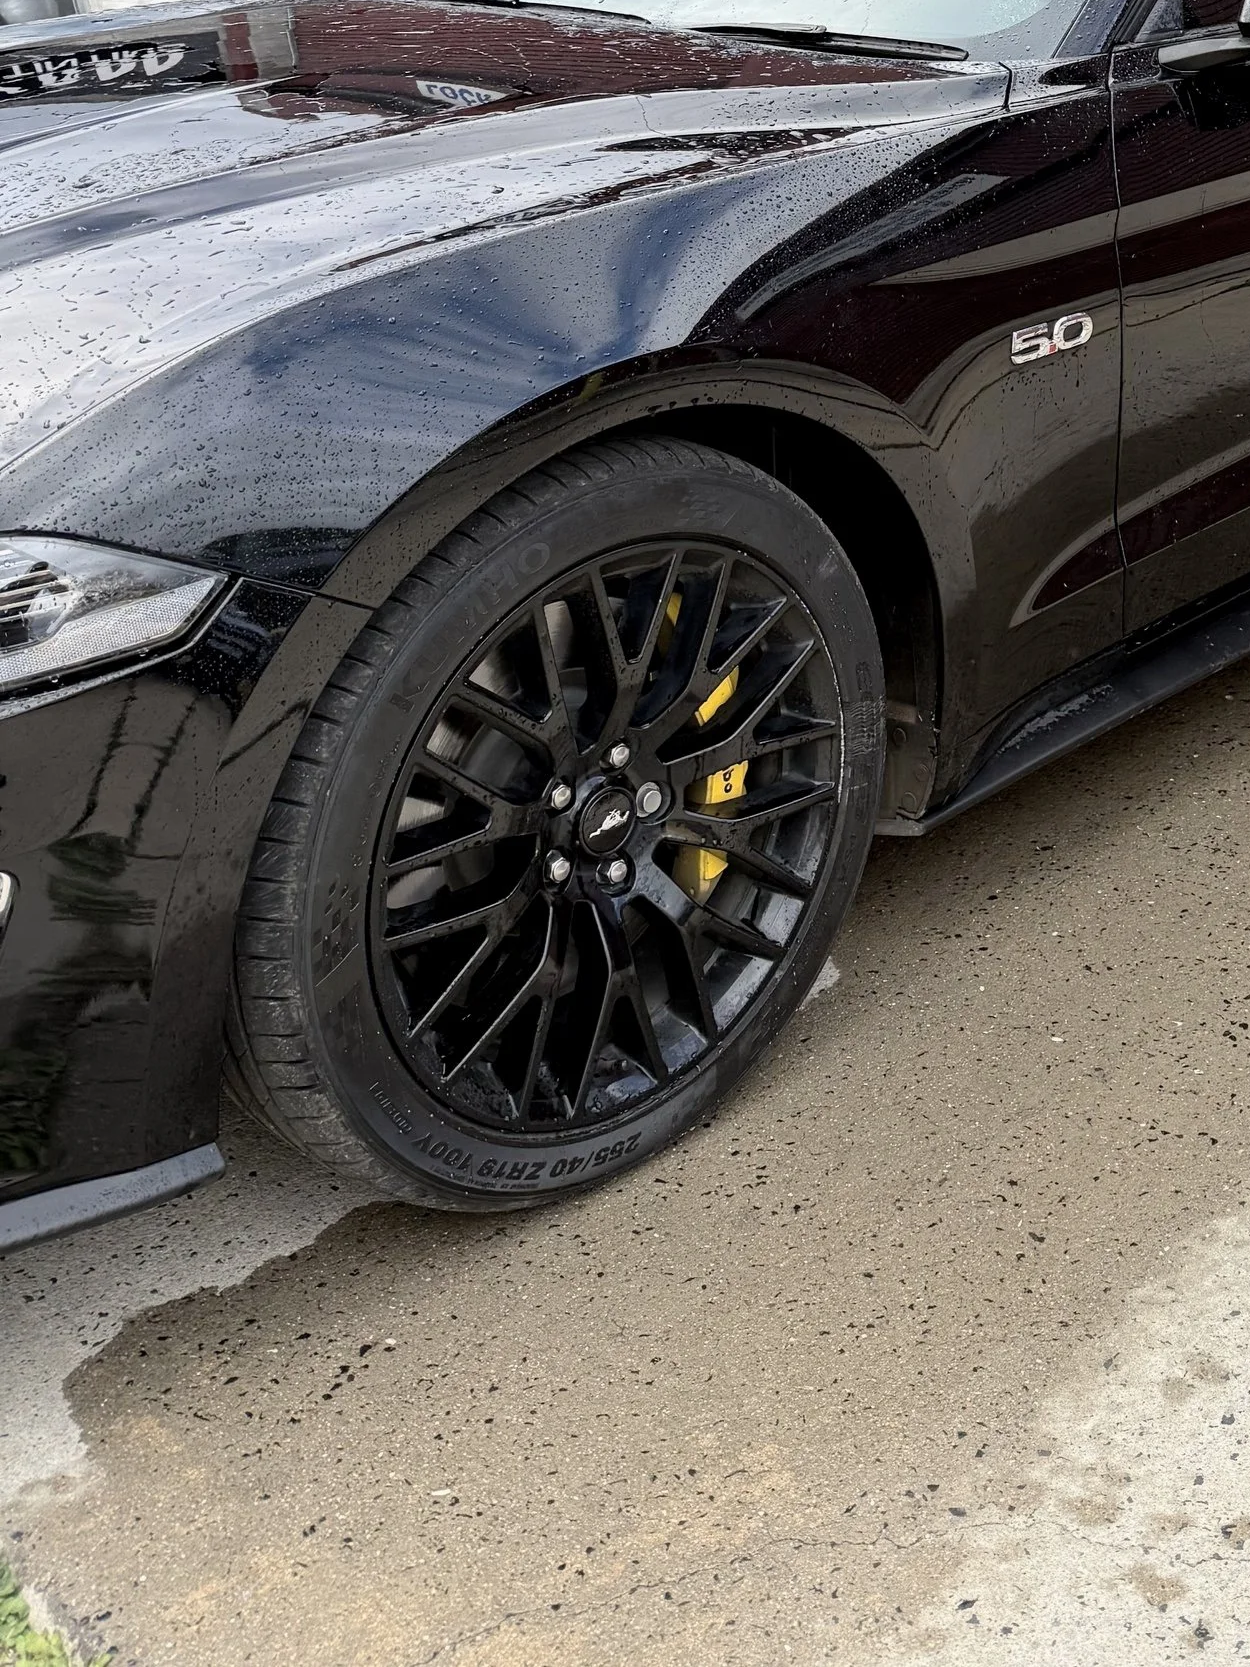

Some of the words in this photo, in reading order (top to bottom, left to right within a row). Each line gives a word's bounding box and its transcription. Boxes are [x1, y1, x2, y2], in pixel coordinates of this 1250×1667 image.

[1011, 312, 1093, 365] 5.0
[476, 1157, 547, 1181] ZR19
[549, 1131, 643, 1178] 255/40
